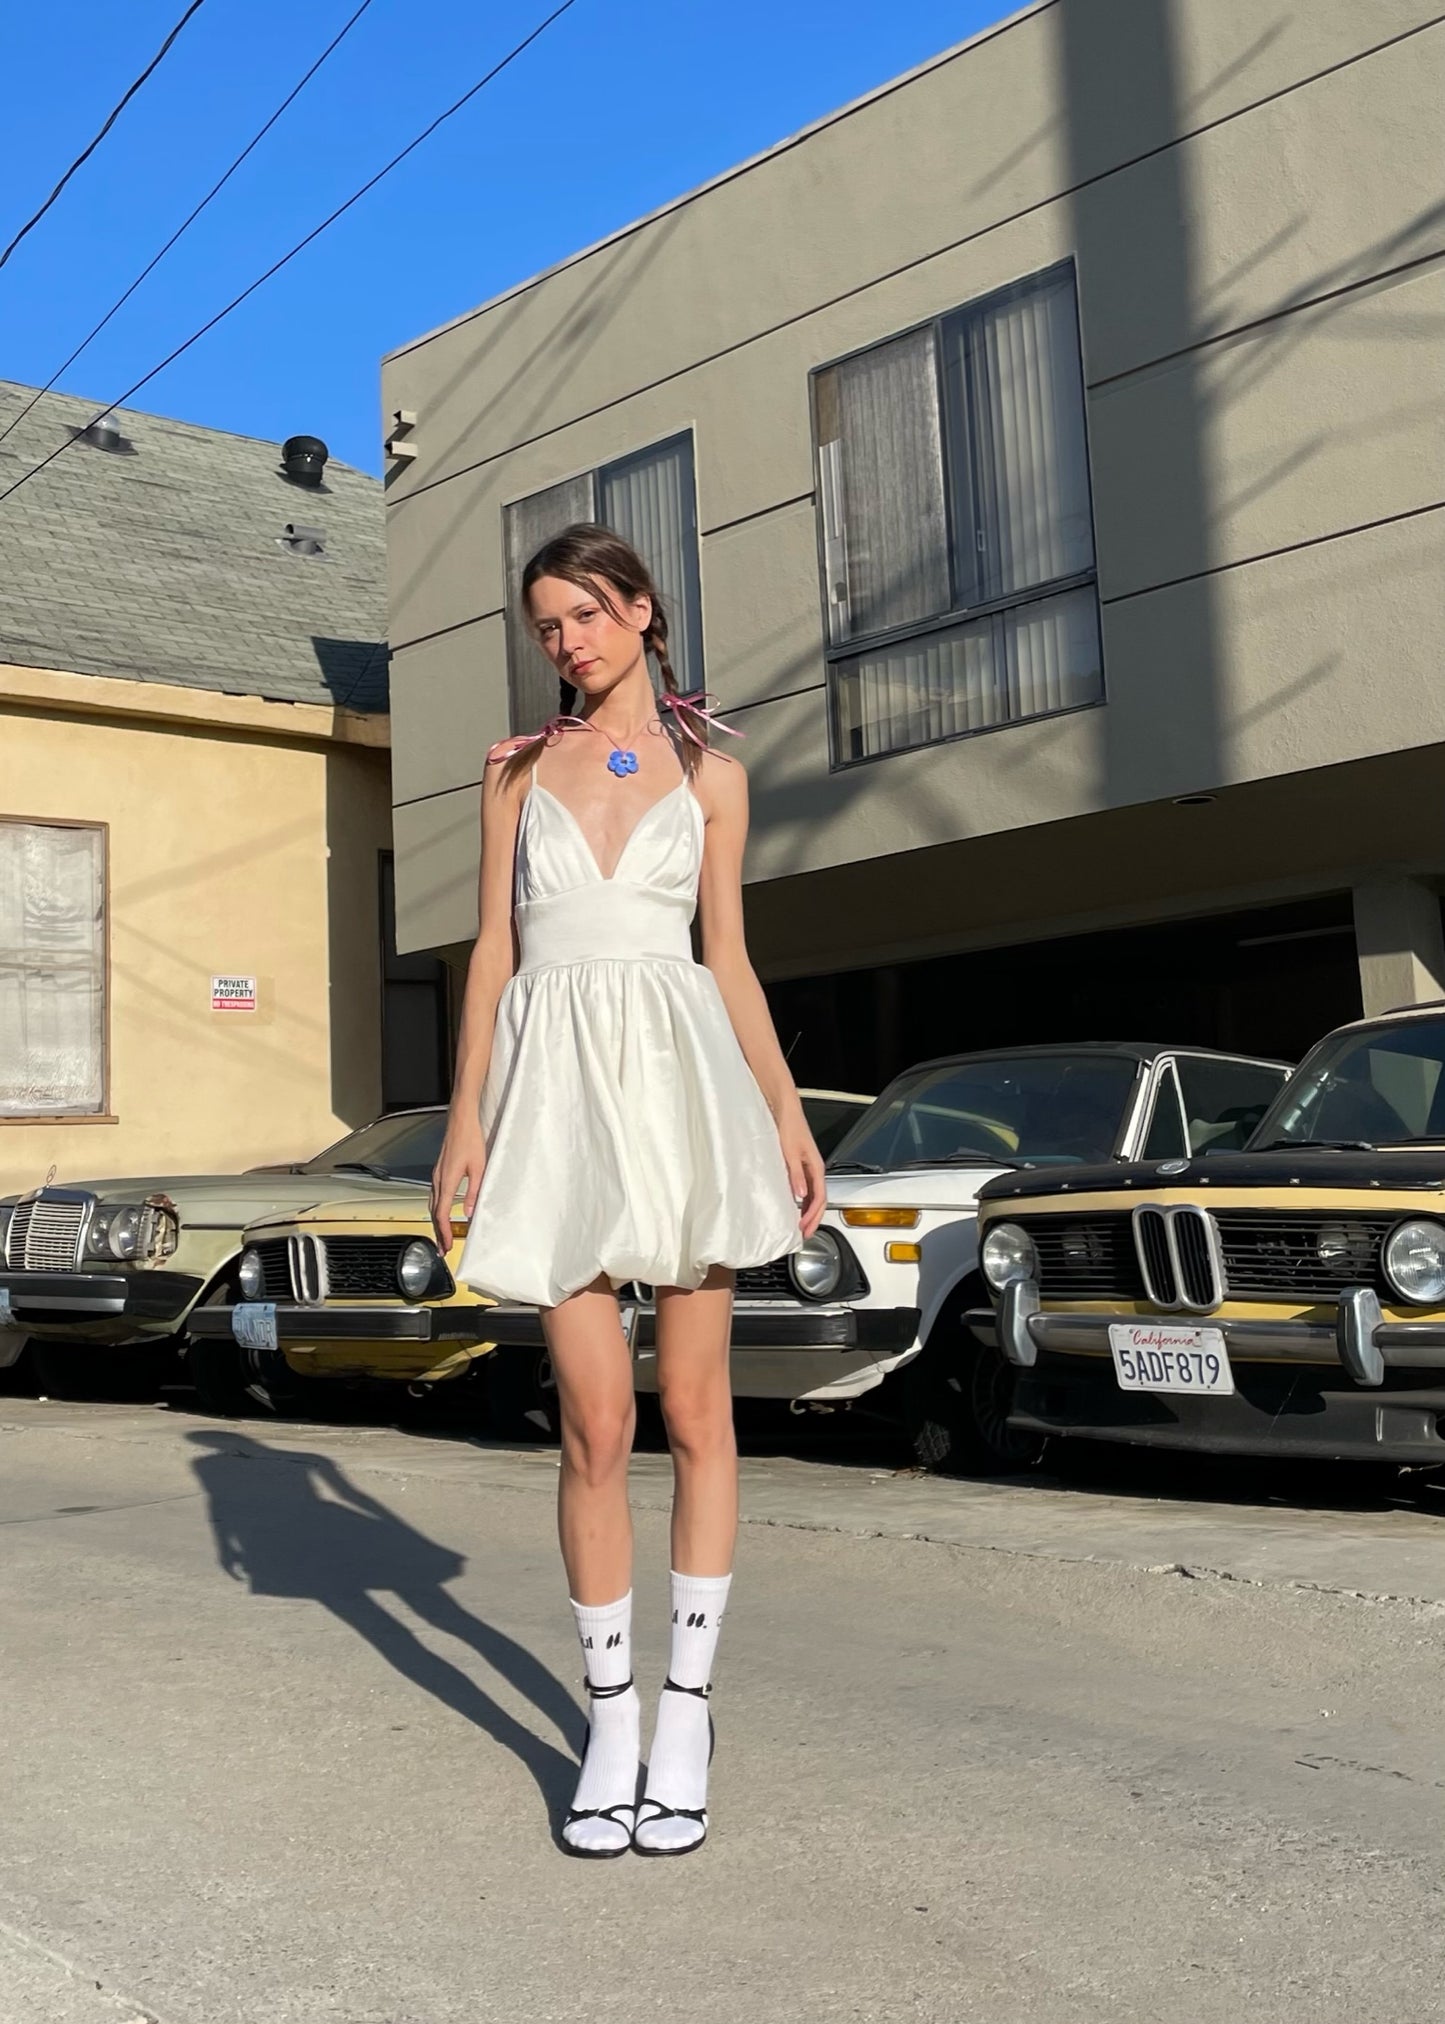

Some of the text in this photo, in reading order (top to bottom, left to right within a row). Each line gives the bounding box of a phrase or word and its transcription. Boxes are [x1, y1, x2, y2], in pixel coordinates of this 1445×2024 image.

[218, 979, 249, 988] PRIVATE
[214, 988, 253, 997] PROPERTY
[1133, 1330, 1194, 1350] California
[1119, 1350, 1219, 1384] 5ADF879
